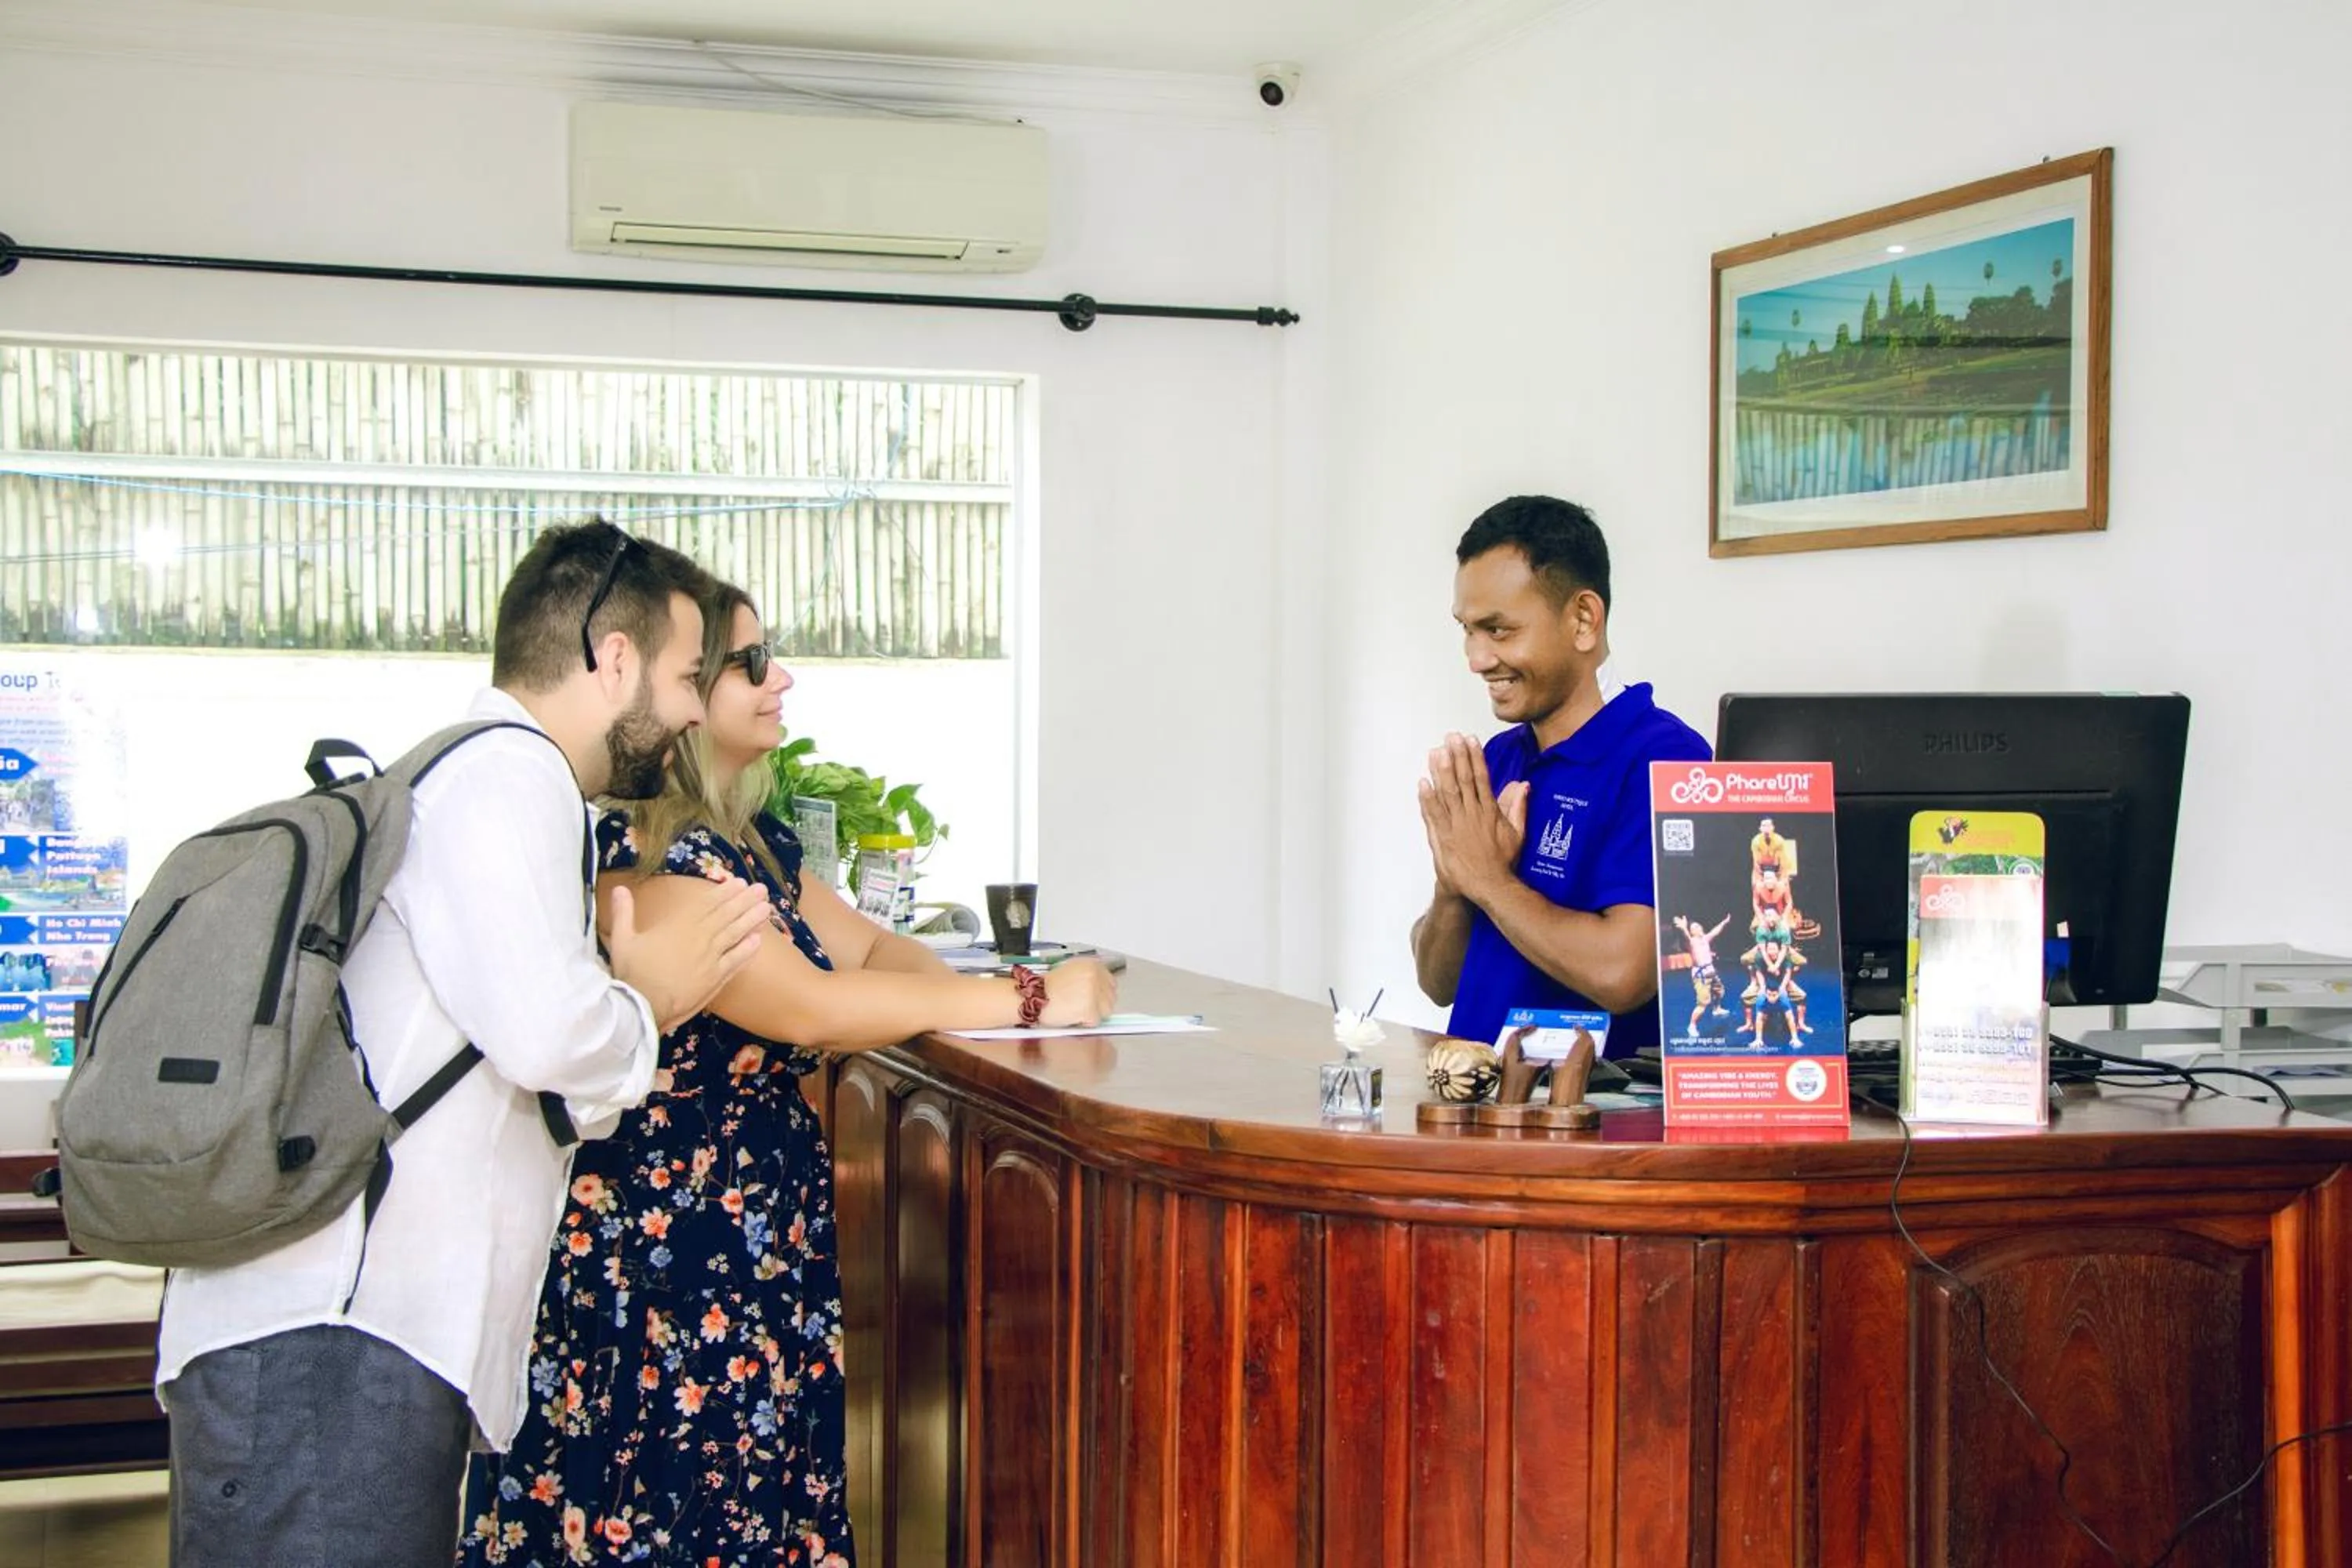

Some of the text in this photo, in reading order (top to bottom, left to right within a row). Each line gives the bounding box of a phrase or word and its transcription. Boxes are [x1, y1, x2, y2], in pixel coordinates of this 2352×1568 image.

[1924, 732, 2010, 753] PHILIPS
[1726, 773, 1777, 790] Phare
[45, 918, 122, 928] Ho Chi Minh
